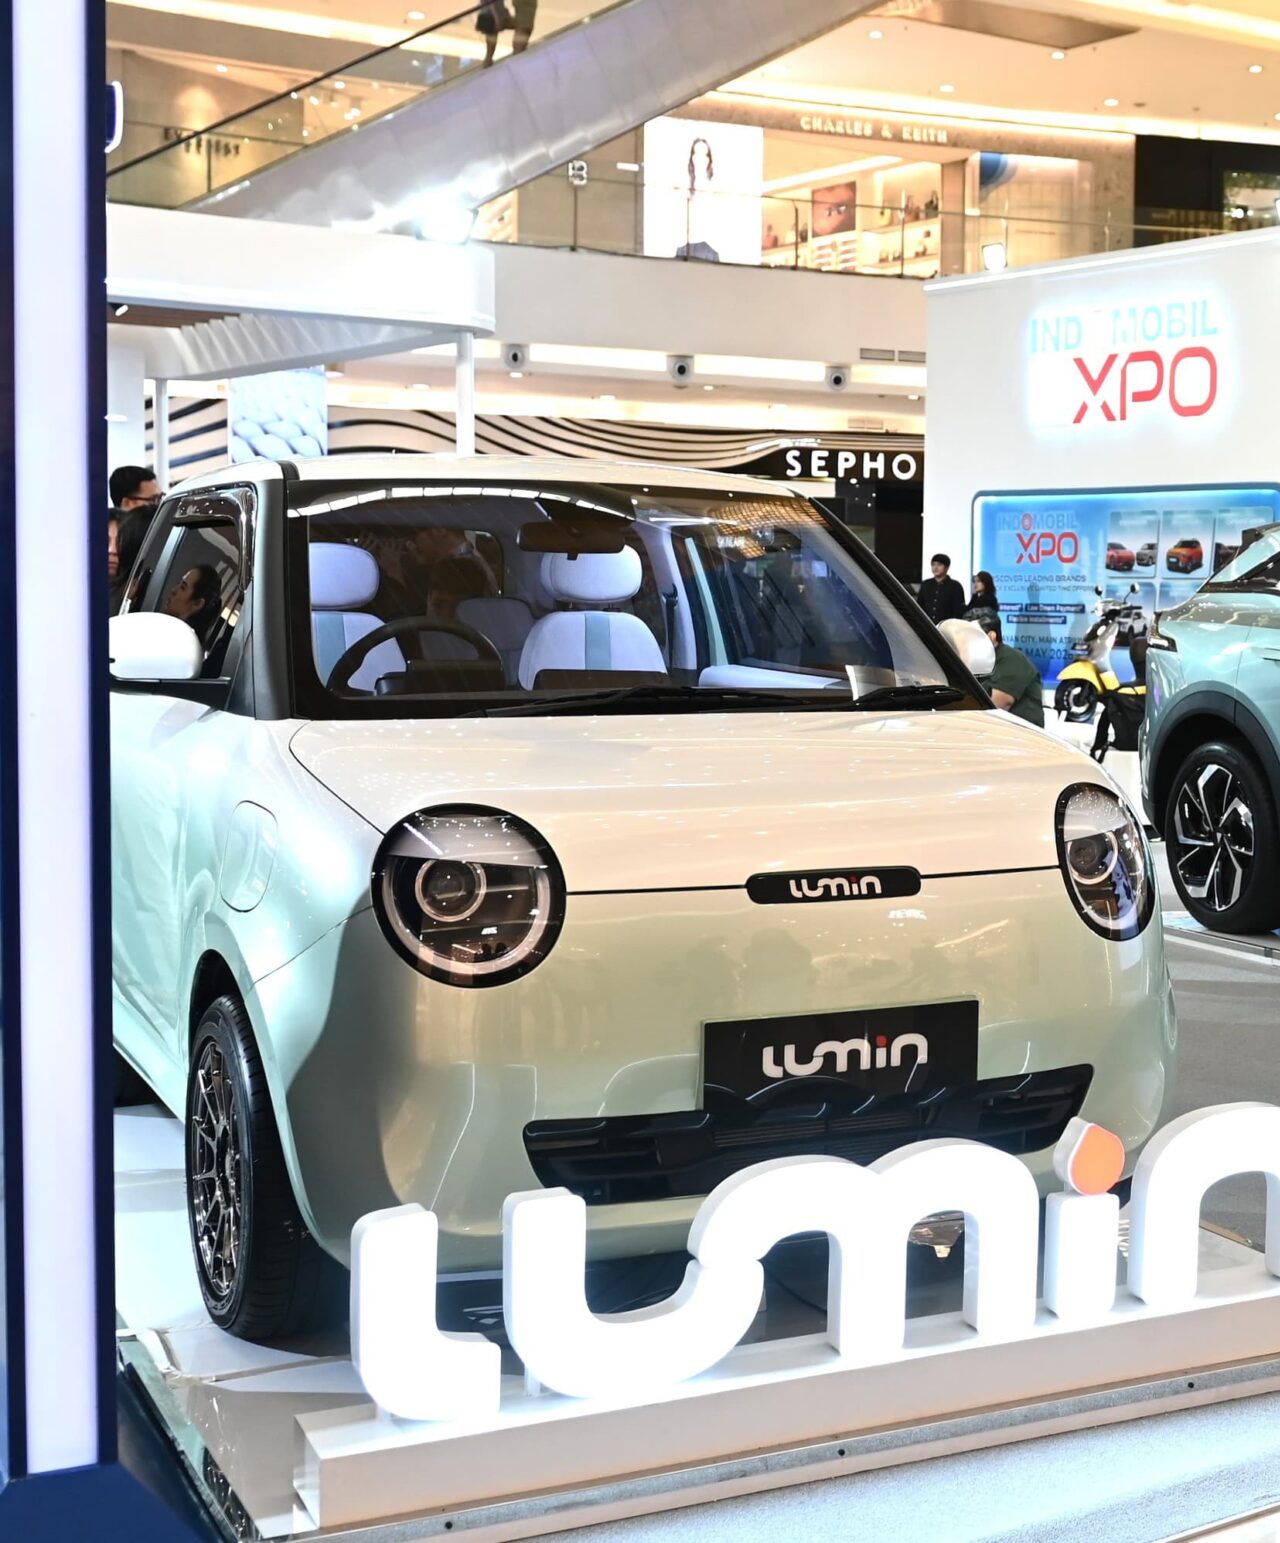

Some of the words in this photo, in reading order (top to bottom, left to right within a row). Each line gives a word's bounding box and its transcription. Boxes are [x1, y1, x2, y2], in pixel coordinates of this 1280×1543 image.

[800, 116, 873, 137] CHARLES
[881, 122, 893, 139] &
[902, 126, 948, 144] KEITH
[1030, 299, 1219, 353] INDMOBIL
[785, 450, 917, 481] SEPHO
[996, 512, 1079, 531] INDOMOBIL
[1024, 574, 1054, 583] LEADING
[1055, 574, 1086, 582] BRANDS
[1038, 635, 1057, 644] MAIN
[1025, 648, 1048, 659] MAY
